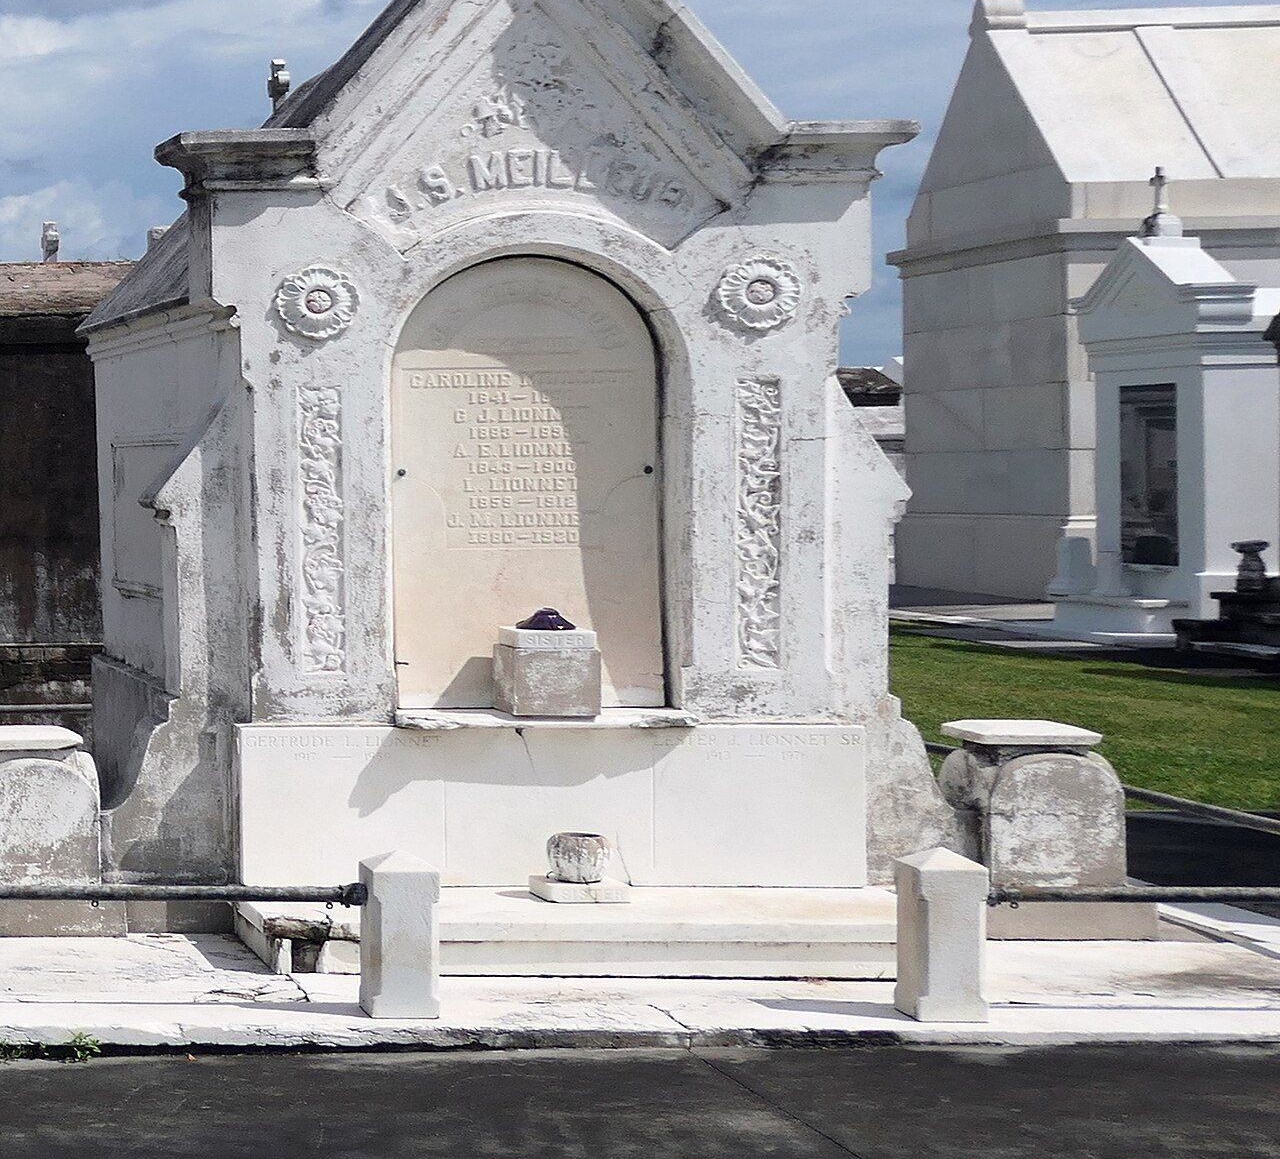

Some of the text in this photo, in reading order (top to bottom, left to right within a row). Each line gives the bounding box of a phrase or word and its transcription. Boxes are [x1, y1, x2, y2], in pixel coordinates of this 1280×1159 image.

[410, 373, 513, 389] CAROLINE
[463, 477, 578, 493] L. LIONNET
[500, 512, 581, 528] LIONNE
[526, 634, 586, 645] SISTER
[245, 734, 443, 748] GERTRUDE L. LIONNET
[748, 734, 830, 747] LIONNET
